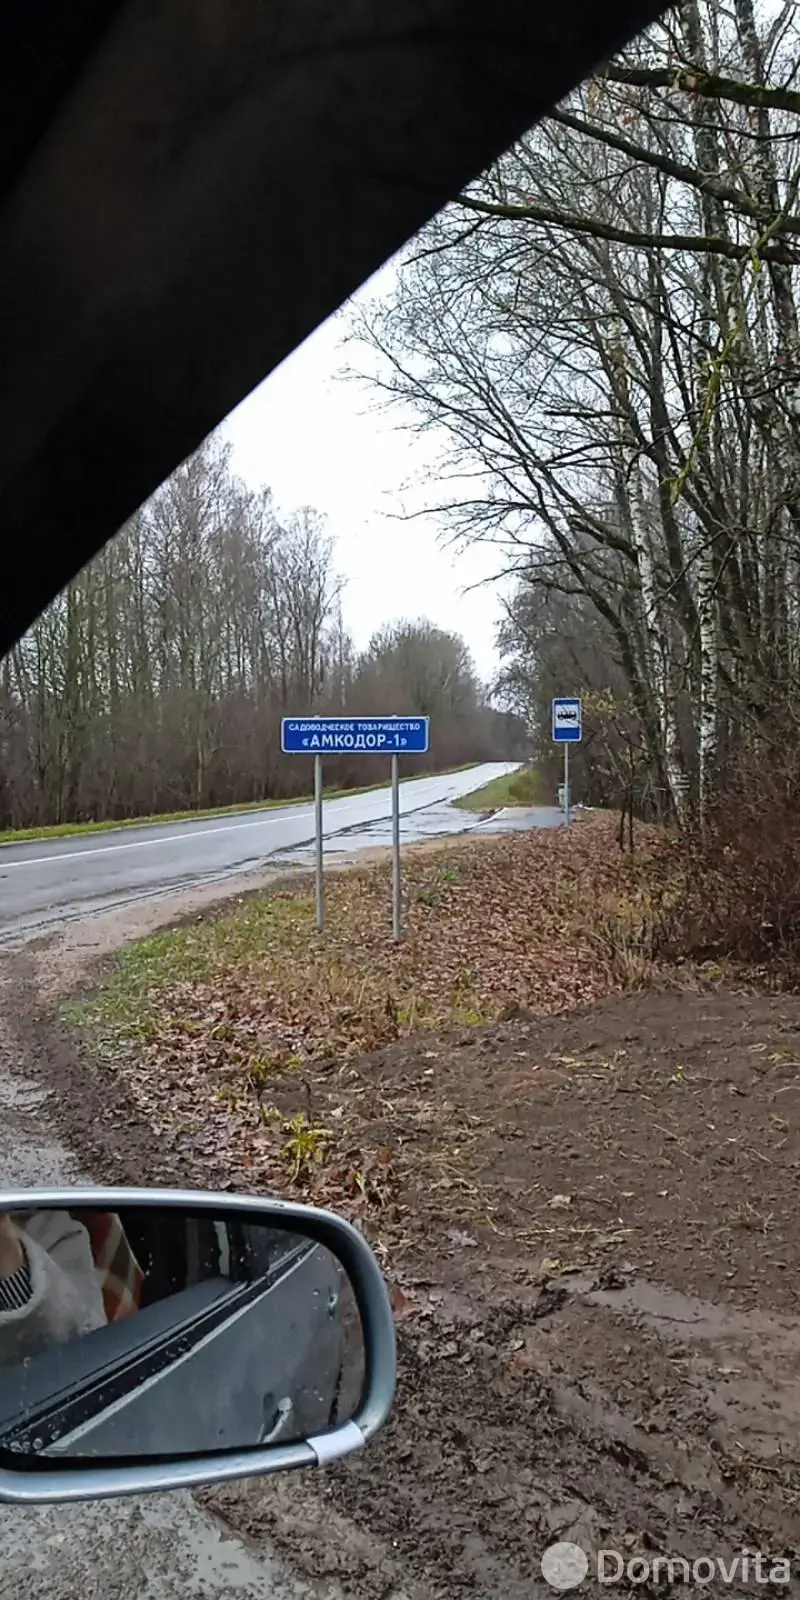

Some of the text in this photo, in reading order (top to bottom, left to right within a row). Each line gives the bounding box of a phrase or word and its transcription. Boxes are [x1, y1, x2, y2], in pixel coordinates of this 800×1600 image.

[288, 723, 421, 731] САДОВОДЧЕСКОЕ ТОВАРИЩЕСТВО
[302, 734, 408, 748] «АМКОДОР-1»
